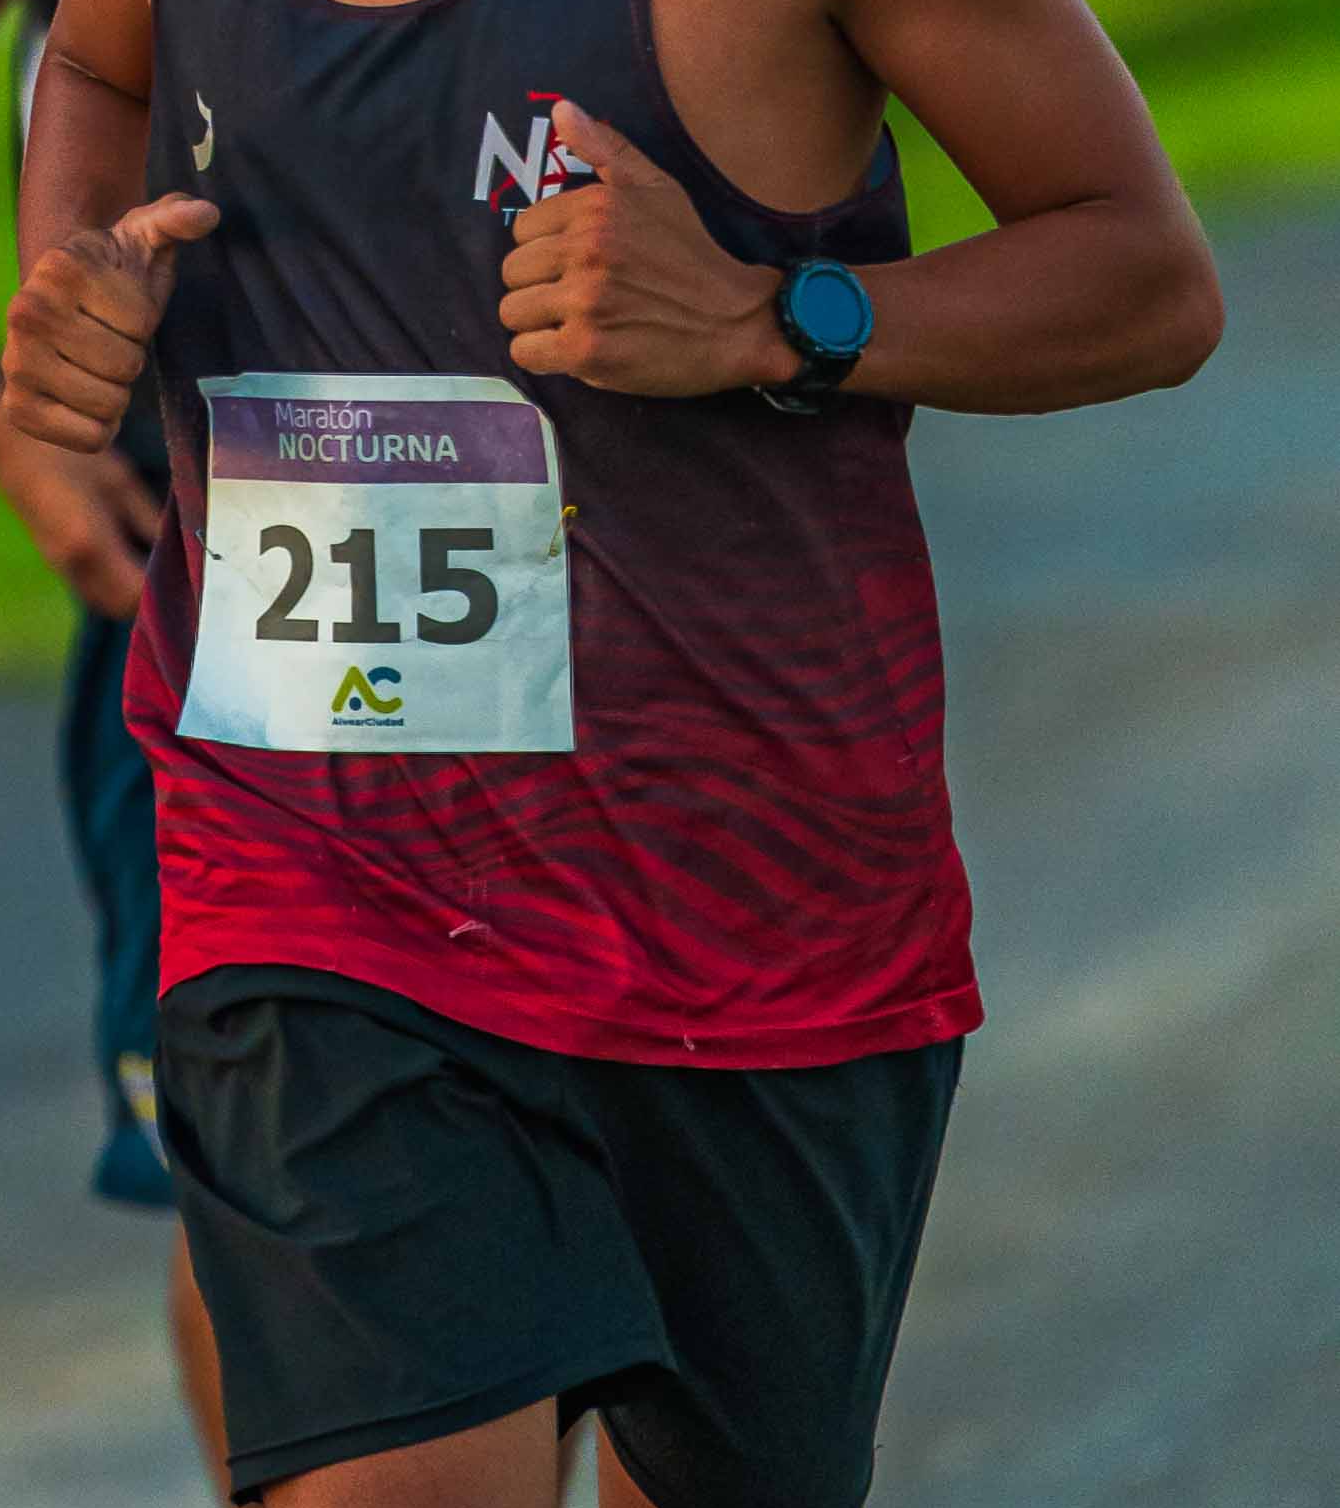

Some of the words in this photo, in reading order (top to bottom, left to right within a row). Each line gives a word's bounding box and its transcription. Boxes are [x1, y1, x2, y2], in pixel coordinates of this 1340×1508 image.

[275, 402, 372, 430] Maratón
[278, 433, 459, 463] NOCTURNA
[255, 524, 499, 645] 215
